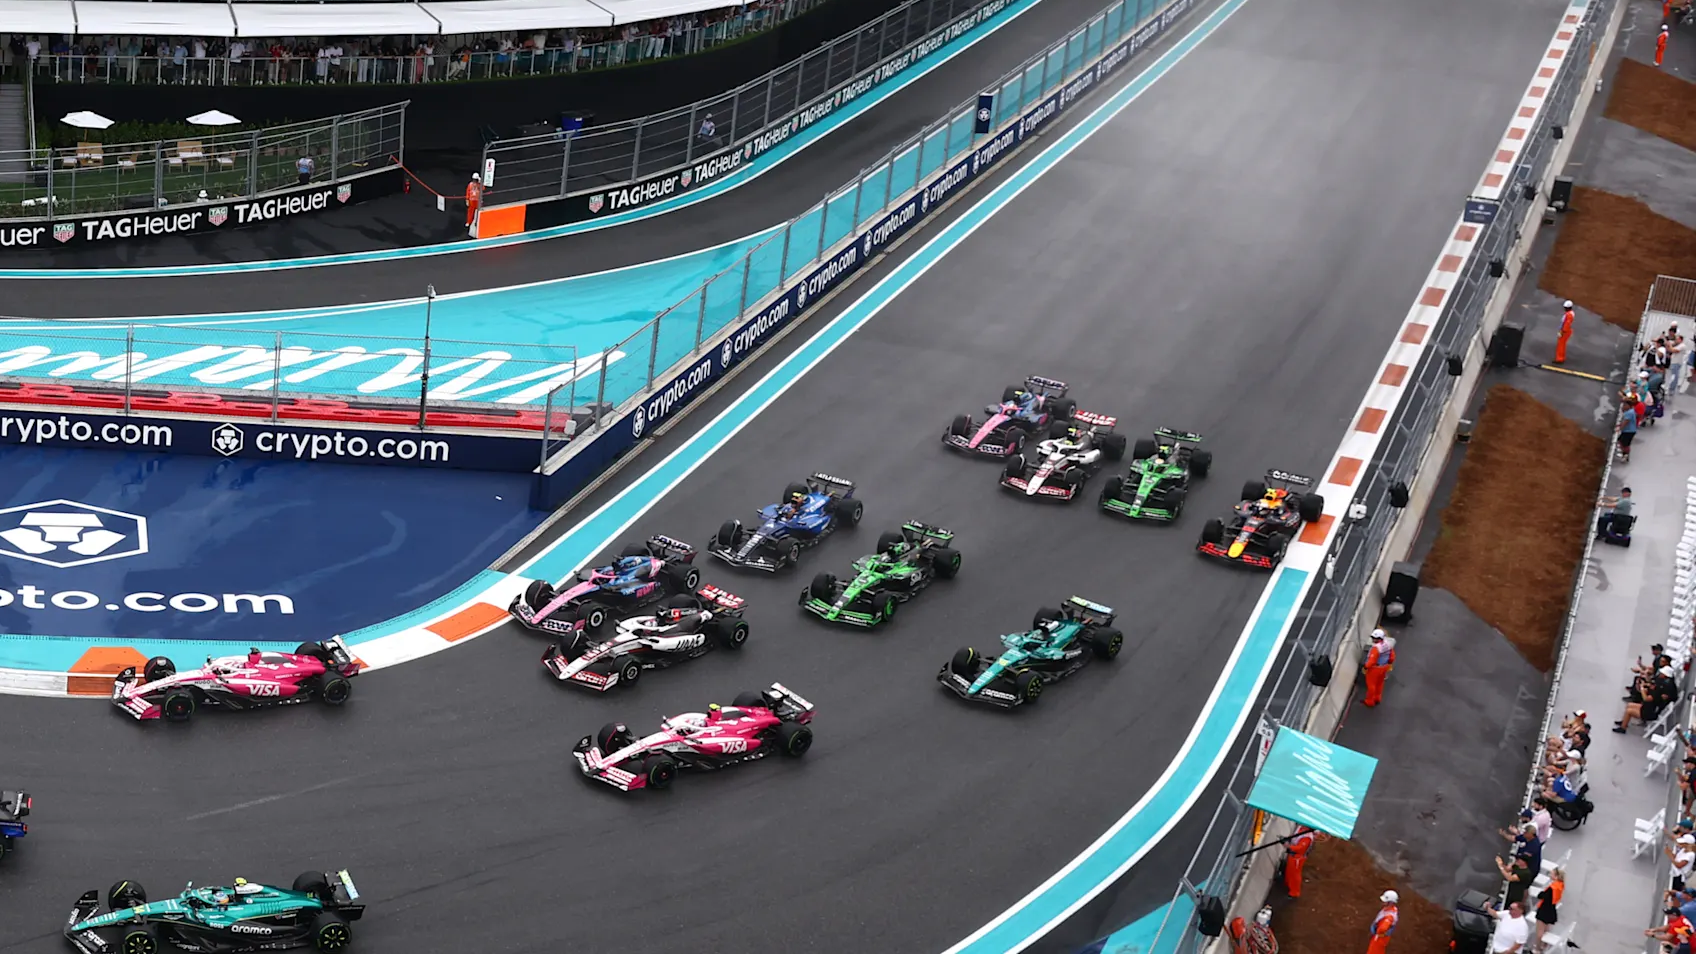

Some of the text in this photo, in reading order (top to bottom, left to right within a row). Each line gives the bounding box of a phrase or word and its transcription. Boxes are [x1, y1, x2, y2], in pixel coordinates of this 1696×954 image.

[1102, 46, 1128, 74] crypto.com
[1064, 71, 1093, 101] crypto.com
[800, 96, 835, 128] TAGHeuer
[1025, 99, 1056, 133] crypto.com
[754, 122, 792, 155] TAGHeuer
[980, 129, 1015, 165] crypto.com
[694, 148, 744, 183] TAGHeuer
[608, 175, 679, 209] TAGHeuer
[930, 163, 968, 203] crypto.com
[210, 207, 228, 215] TAG
[234, 190, 333, 223] TAGHeuer
[55, 224, 74, 232] TAG
[82, 210, 202, 240] TAGHeuer
[874, 203, 916, 246] crypto.com
[808, 246, 856, 296] crypto.com
[734, 298, 789, 355] crypto.com
[648, 358, 712, 421] crypto.com
[256, 431, 449, 461] crypto.com
[248, 685, 280, 696] VISA
[720, 740, 748, 753] VISA
[232, 925, 272, 935] aramco
